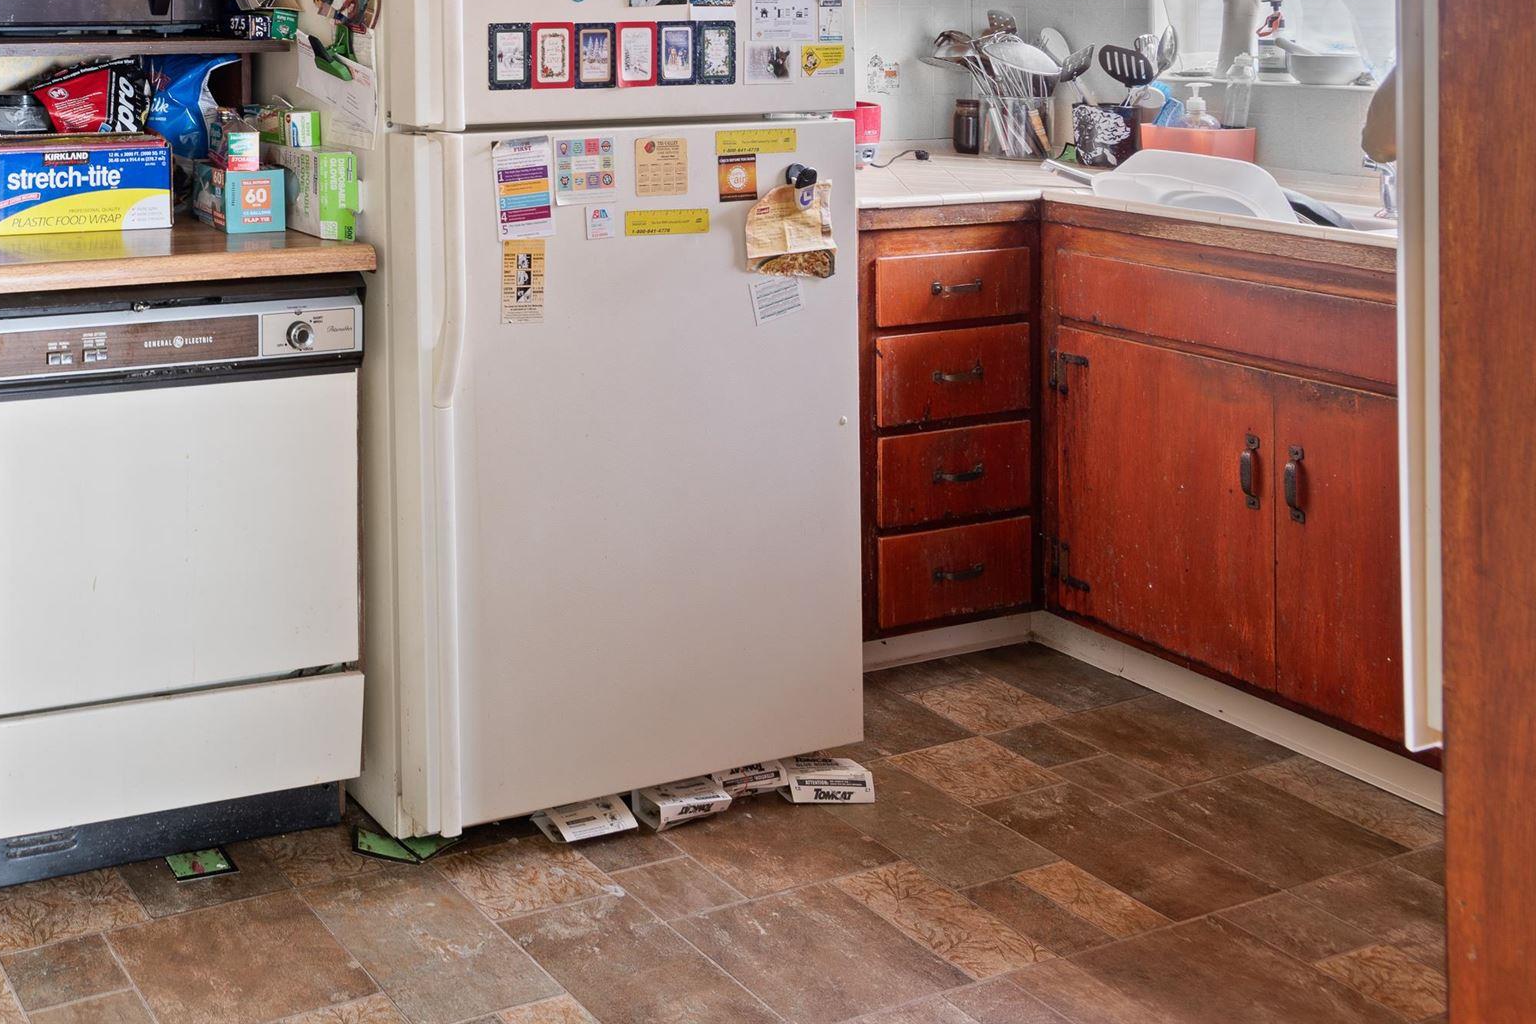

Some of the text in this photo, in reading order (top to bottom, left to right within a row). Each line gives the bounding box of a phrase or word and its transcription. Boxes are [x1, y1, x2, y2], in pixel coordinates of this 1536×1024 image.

[230, 18, 246, 29] 37.5
[255, 17, 264, 37] 37.5
[115, 76, 138, 132] pro
[513, 145, 532, 153] FIRST
[45, 153, 88, 161] KIRKLAND
[7, 165, 121, 190] stretch-tite
[338, 158, 346, 209] DISPOSABLE
[245, 188, 267, 203] 60
[12, 216, 54, 228] PLASTIC
[56, 215, 86, 226] FOOD
[88, 213, 122, 224] WRAP
[143, 336, 213, 349] GENERAL ELECTRIC
[814, 788, 854, 800] TOMCAT
[678, 803, 713, 815] TOMCAT
